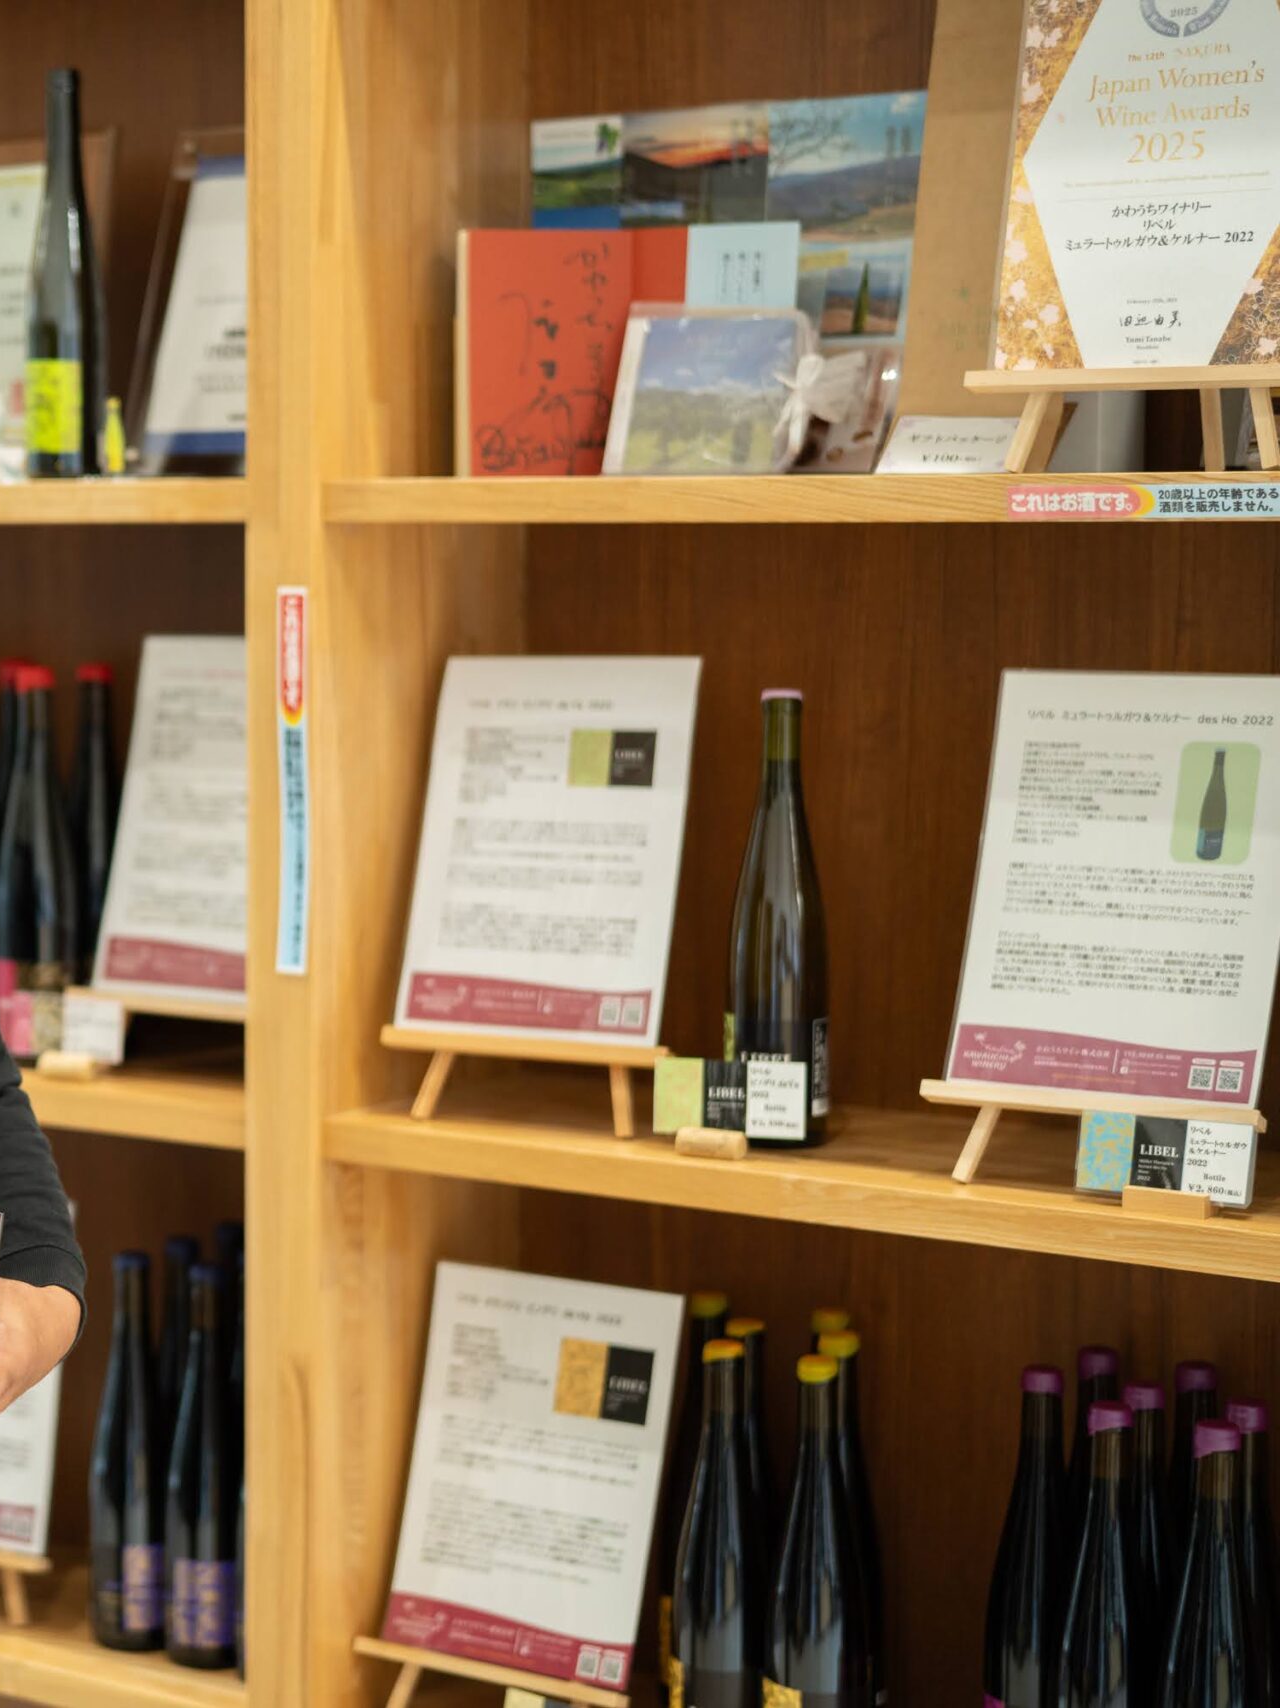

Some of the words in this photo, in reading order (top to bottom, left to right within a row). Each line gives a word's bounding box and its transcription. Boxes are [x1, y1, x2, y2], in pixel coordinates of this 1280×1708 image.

[1089, 74, 1151, 102] Japan
[1157, 60, 1265, 90] Women's
[1096, 105, 1156, 128] Wine
[1163, 96, 1250, 124] Awards
[1127, 129, 1207, 164] 2025
[1111, 202, 1212, 218] かわうちワイナリー
[1143, 219, 1176, 230] リベル
[1224, 230, 1254, 244] 2022
[1158, 488, 1279, 501] 20歳以上の年齢である
[1011, 491, 1134, 512] これはお酒です。
[1159, 500, 1274, 513] 酒類を販売しません。
[1242, 715, 1274, 726] 2022
[1190, 1126, 1212, 1135] リベル
[1140, 1143, 1179, 1158] LIBEL
[1187, 1158, 1208, 1167] 2022
[1203, 1172, 1226, 1182] Bottle
